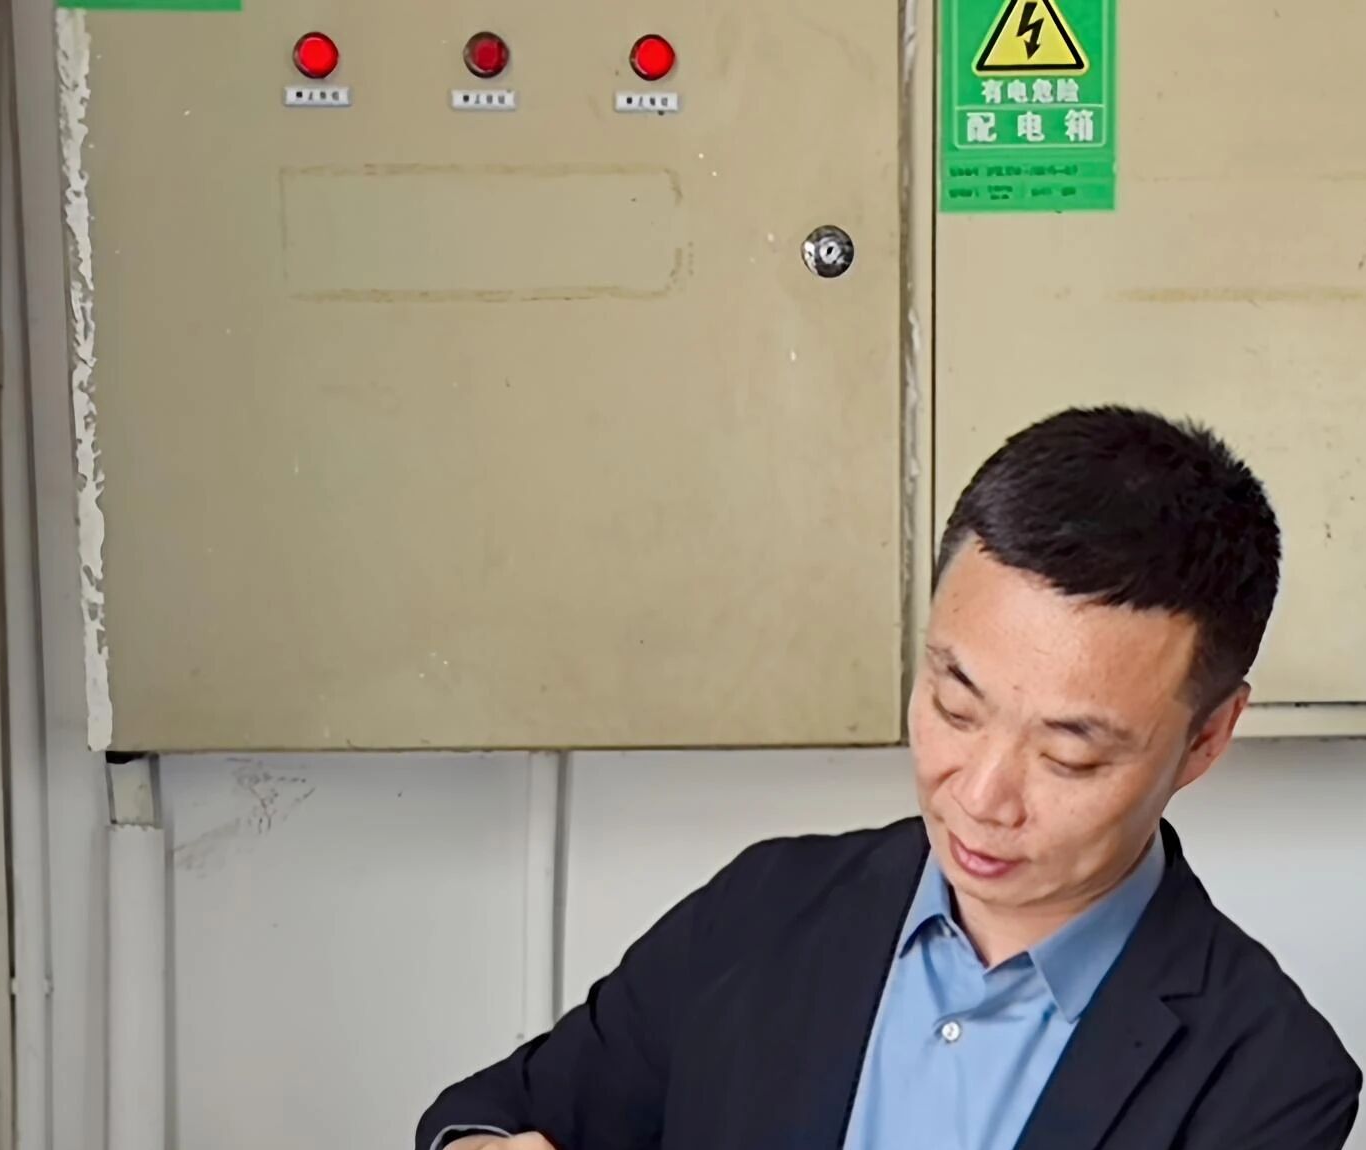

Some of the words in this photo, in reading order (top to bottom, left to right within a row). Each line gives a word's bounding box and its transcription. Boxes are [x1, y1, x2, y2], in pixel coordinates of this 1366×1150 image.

[981, 79, 1079, 104] 有电危险
[966, 109, 1095, 142] 配电箱
